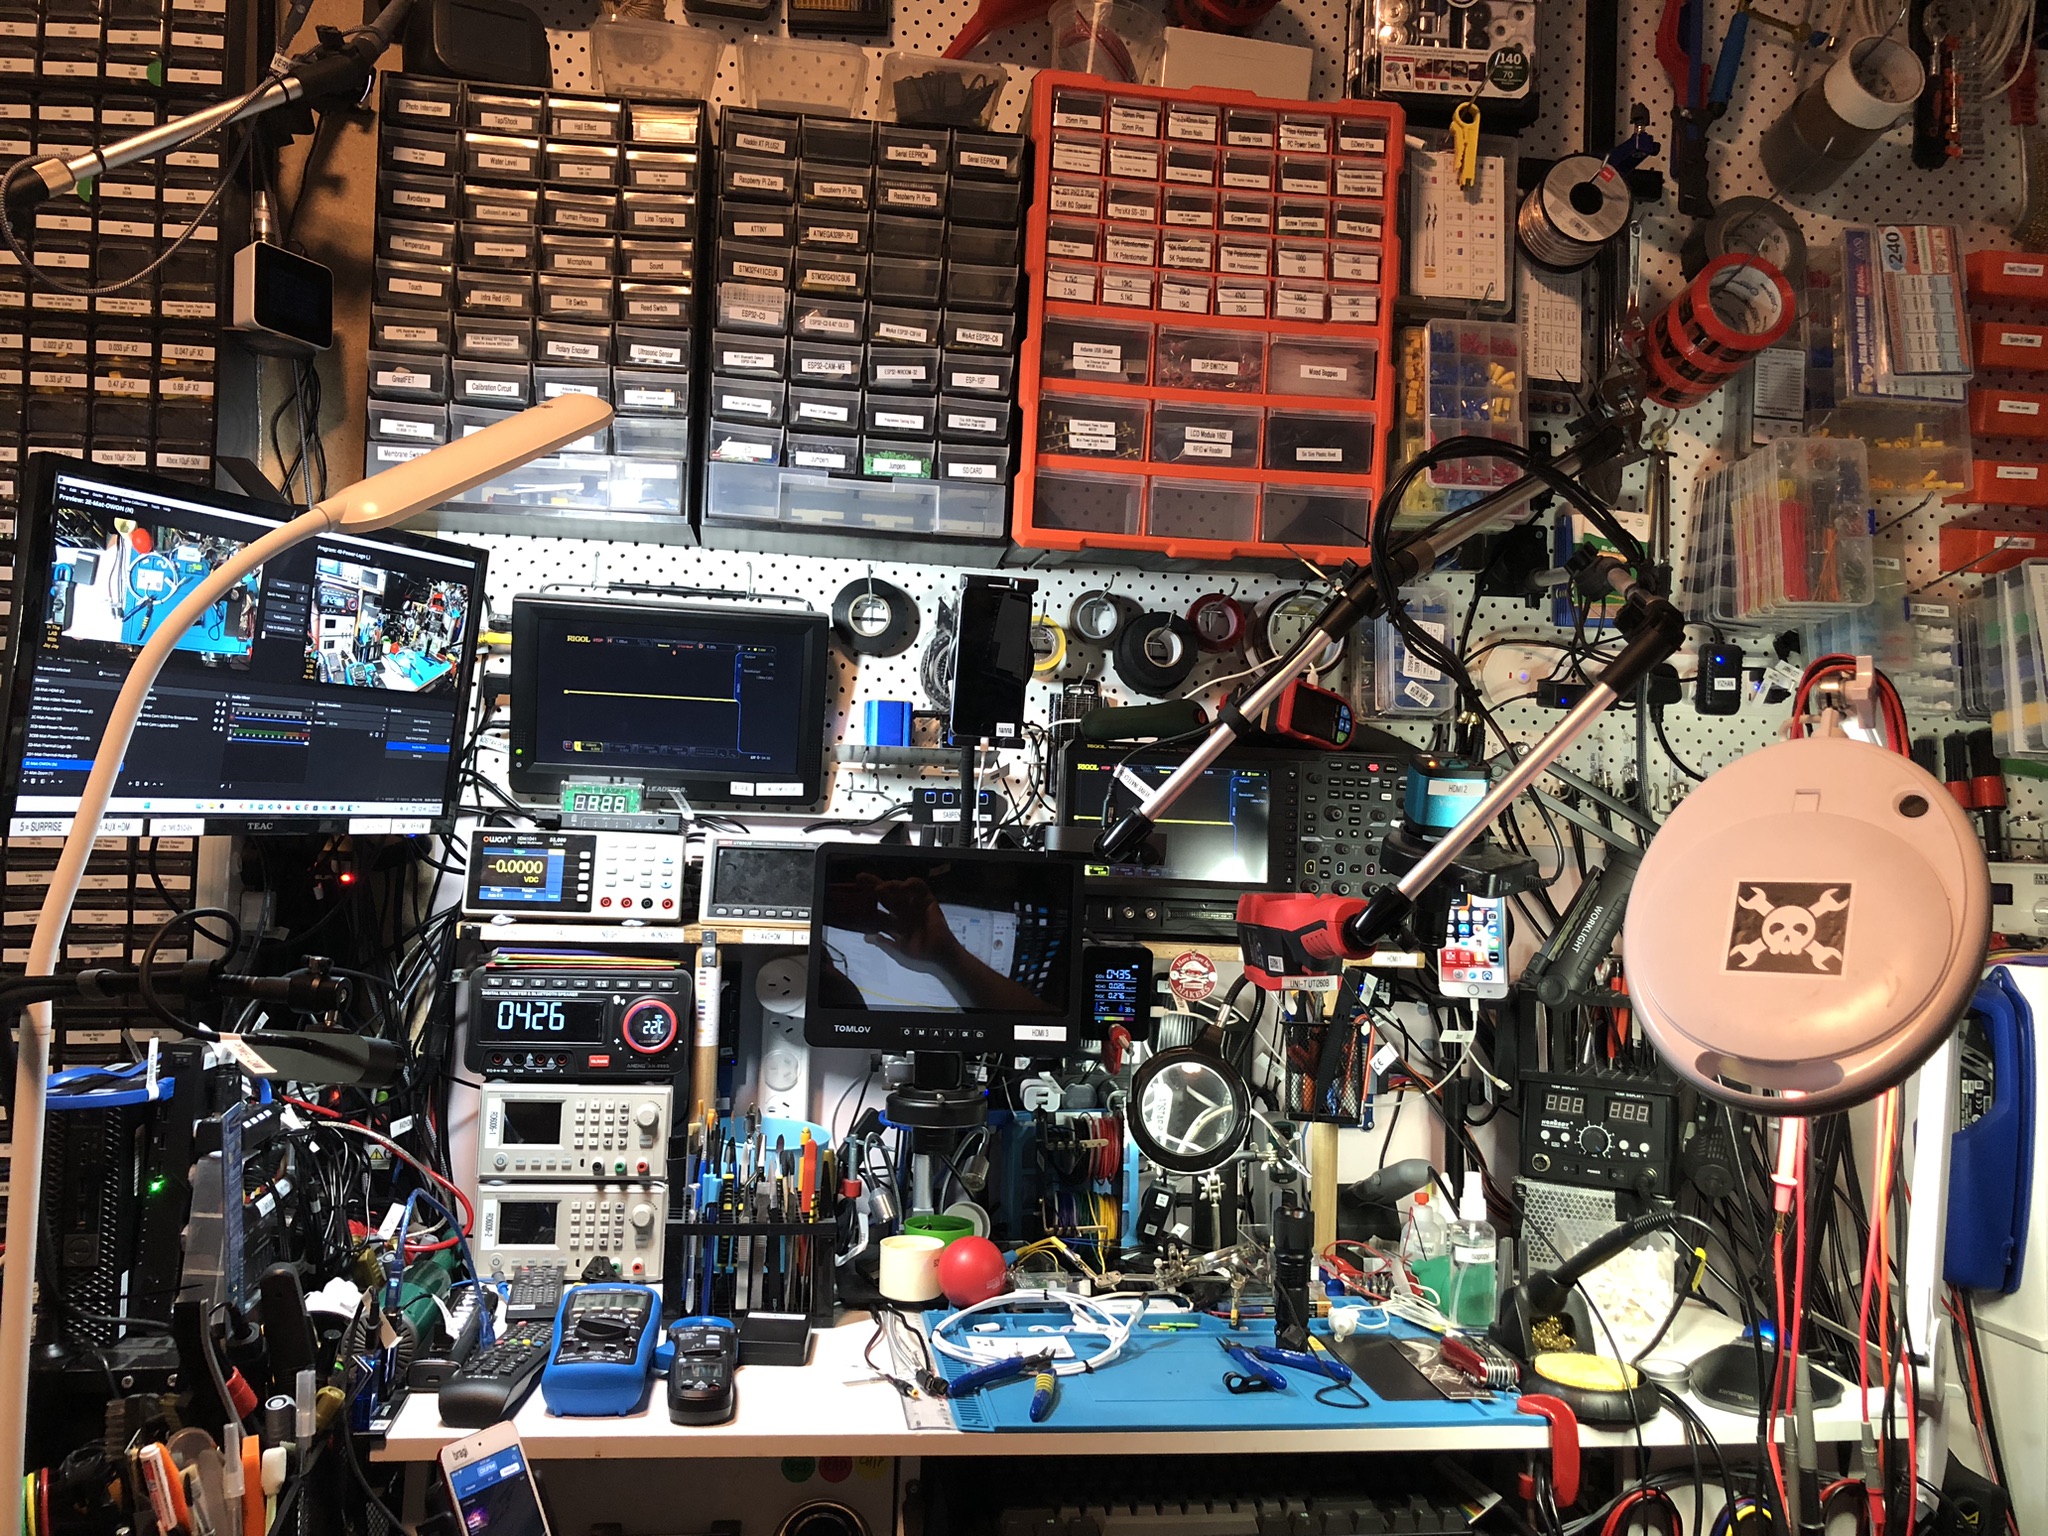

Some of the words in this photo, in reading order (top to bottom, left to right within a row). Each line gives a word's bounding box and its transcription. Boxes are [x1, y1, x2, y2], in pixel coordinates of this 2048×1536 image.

[1503, 71, 1513, 79] 70
[419, 104, 442, 113] Interrupter
[1238, 135, 1251, 144] Safety
[1287, 140, 1294, 148] PC
[908, 150, 928, 159] EEPROM
[504, 158, 517, 166] Level
[967, 155, 979, 163] Serial
[980, 156, 1000, 165] EEPROM
[739, 175, 759, 185] Raspberry
[766, 178, 777, 186] Zero
[820, 184, 839, 195] Raspberry
[847, 187, 857, 195] Pico
[407, 194, 431, 203] Avoidance
[894, 192, 913, 201] Raspberry
[644, 215, 655, 223] Line
[656, 215, 674, 224] Tracking
[402, 240, 431, 250] Temperature
[1886, 232, 1902, 264] 240
[1120, 253, 1148, 261] Potentiometer
[1176, 256, 1204, 264] Potentiometer
[567, 258, 592, 267] Microphone
[649, 261, 663, 270] Sound
[739, 266, 778, 277] STM32F411CEU6
[408, 282, 422, 291] Touch
[641, 304, 651, 312] Reed
[652, 304, 667, 312] Switch
[742, 310, 766, 320] ESP32-C3
[556, 344, 571, 354] Rotary
[572, 346, 590, 355] Encoder
[638, 348, 657, 357] Ultrasonic
[658, 349, 673, 358] Sensor
[392, 375, 415, 383] GreatFET
[472, 383, 496, 392] Calibration
[497, 384, 511, 392] Circuit
[1217, 432, 1227, 440] 1602
[127, 454, 136, 462] 25V
[191, 458, 200, 466] 50V
[567, 635, 590, 643] RIGOL
[1077, 763, 1099, 771] RIGOL
[30, 822, 62, 832] SURPRISE
[247, 822, 273, 830] TEAC
[488, 860, 543, 874] -0.0000
[1572, 905, 1604, 953] WORKLIGHT
[1106, 969, 1131, 980] 0435
[1175, 985, 1211, 1000] MAKERS
[497, 1001, 565, 1031] 0426
[834, 1025, 871, 1033] TOMLOV
